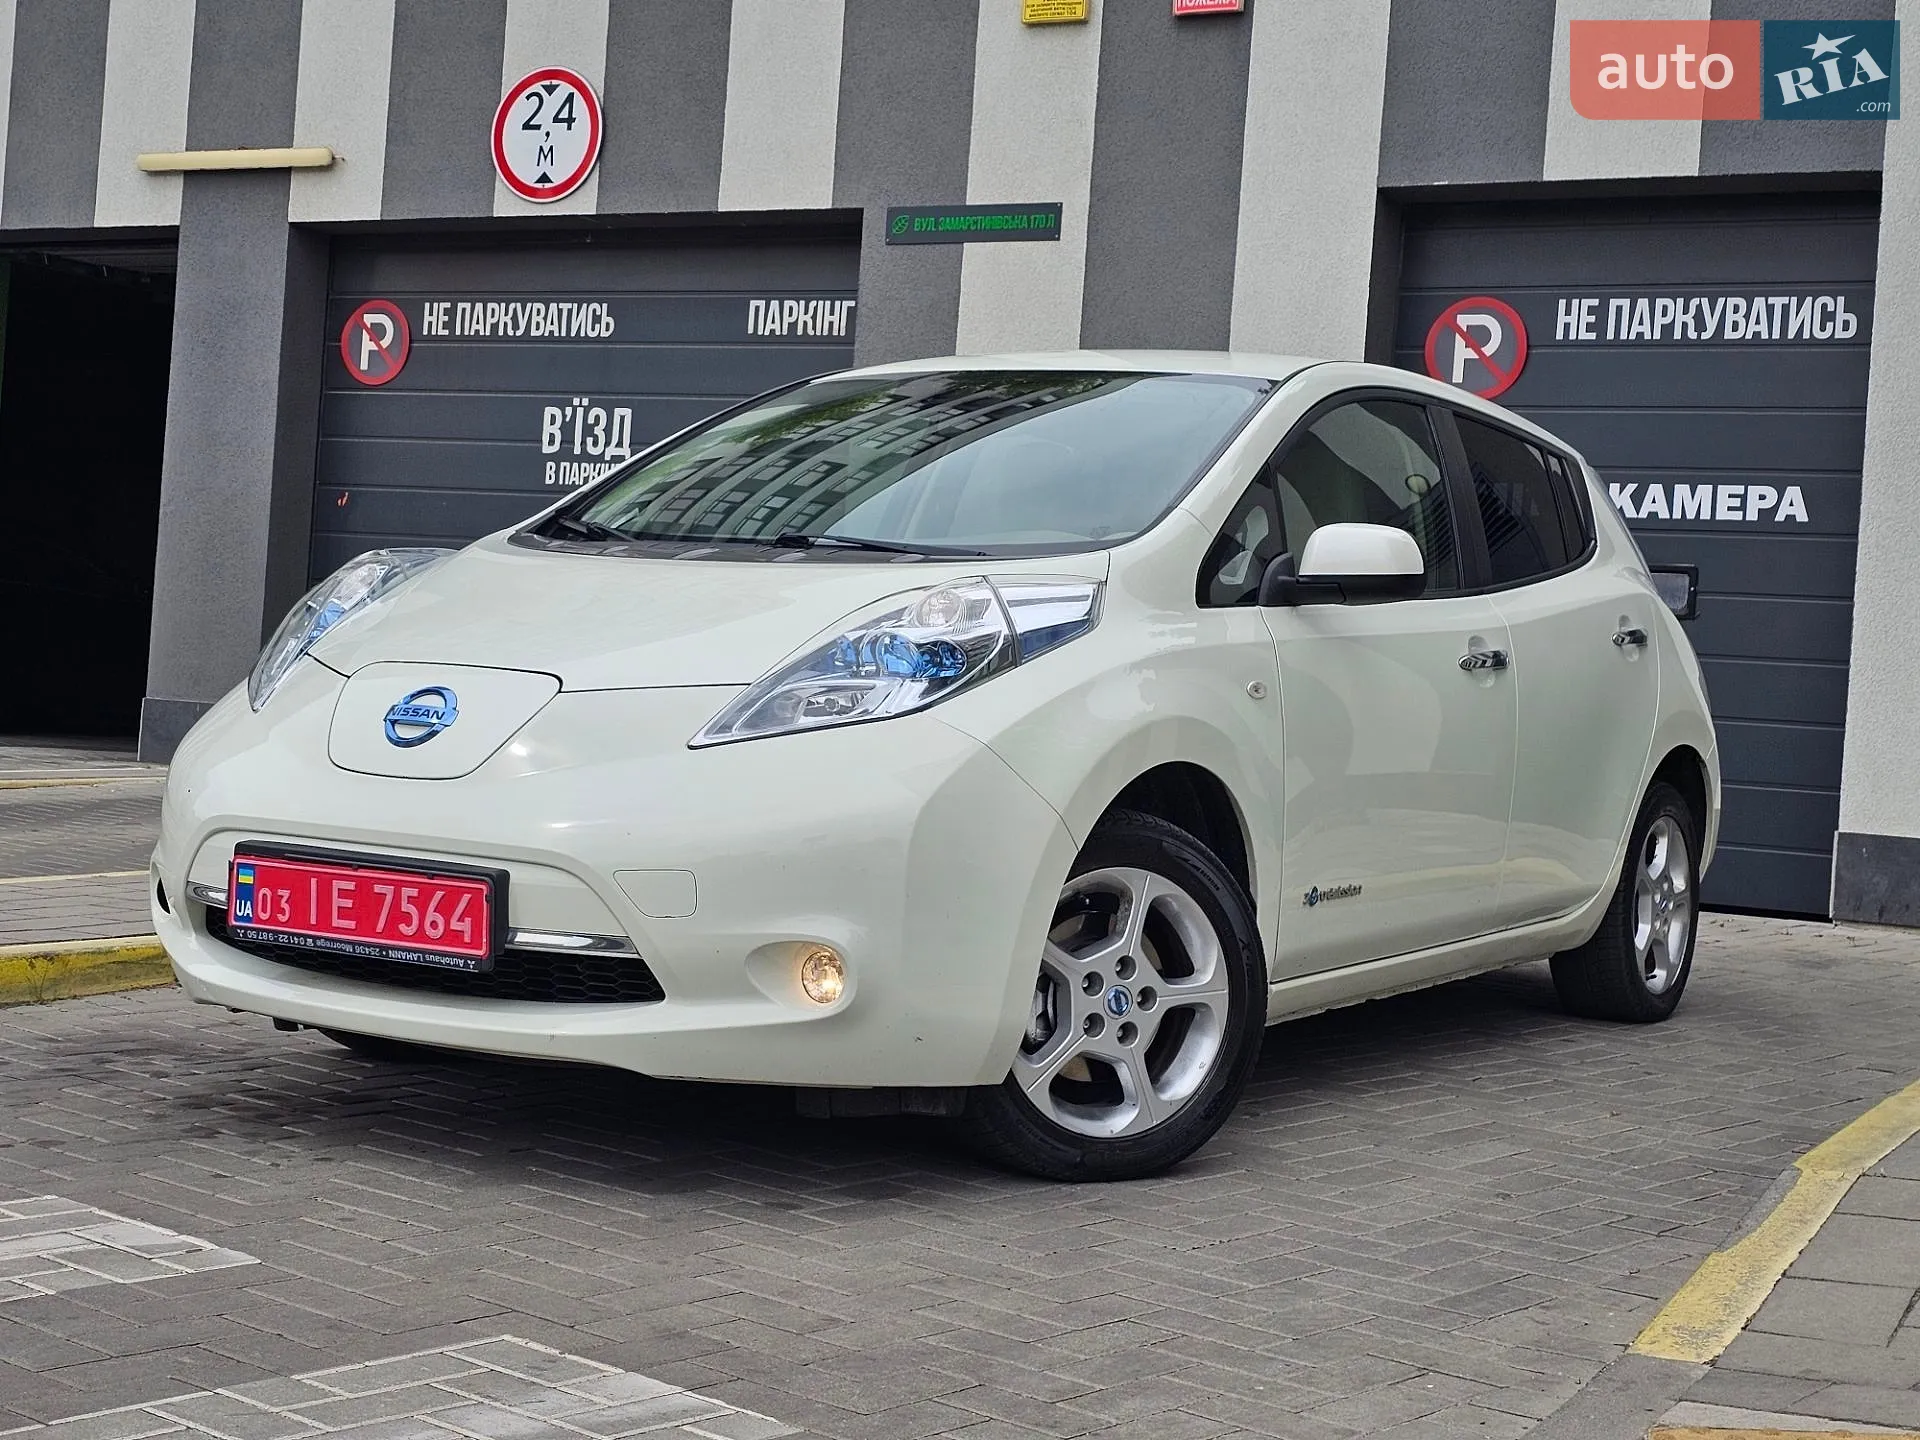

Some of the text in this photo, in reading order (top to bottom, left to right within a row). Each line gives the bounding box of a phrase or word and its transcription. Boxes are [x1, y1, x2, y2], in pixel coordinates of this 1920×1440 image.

[1030, 214, 1045, 229] 170
[422, 302, 615, 338] НЕ ПАРКУВАТИСЬ
[747, 300, 856, 336] ПАРКІНГ
[1555, 295, 1859, 340] НЕ ПАРКУВАТИСЬ
[542, 397, 633, 461] В'ЇЗД
[545, 462, 556, 485] В
[1608, 483, 1809, 522] КАМЕРА
[391, 706, 446, 721] NISSAN
[236, 899, 253, 917] UA
[257, 888, 290, 922] 03
[373, 883, 473, 943] 7564
[355, 944, 380, 956] 25436
[389, 949, 423, 962] LAHANN
[425, 954, 464, 968] Autohaus
